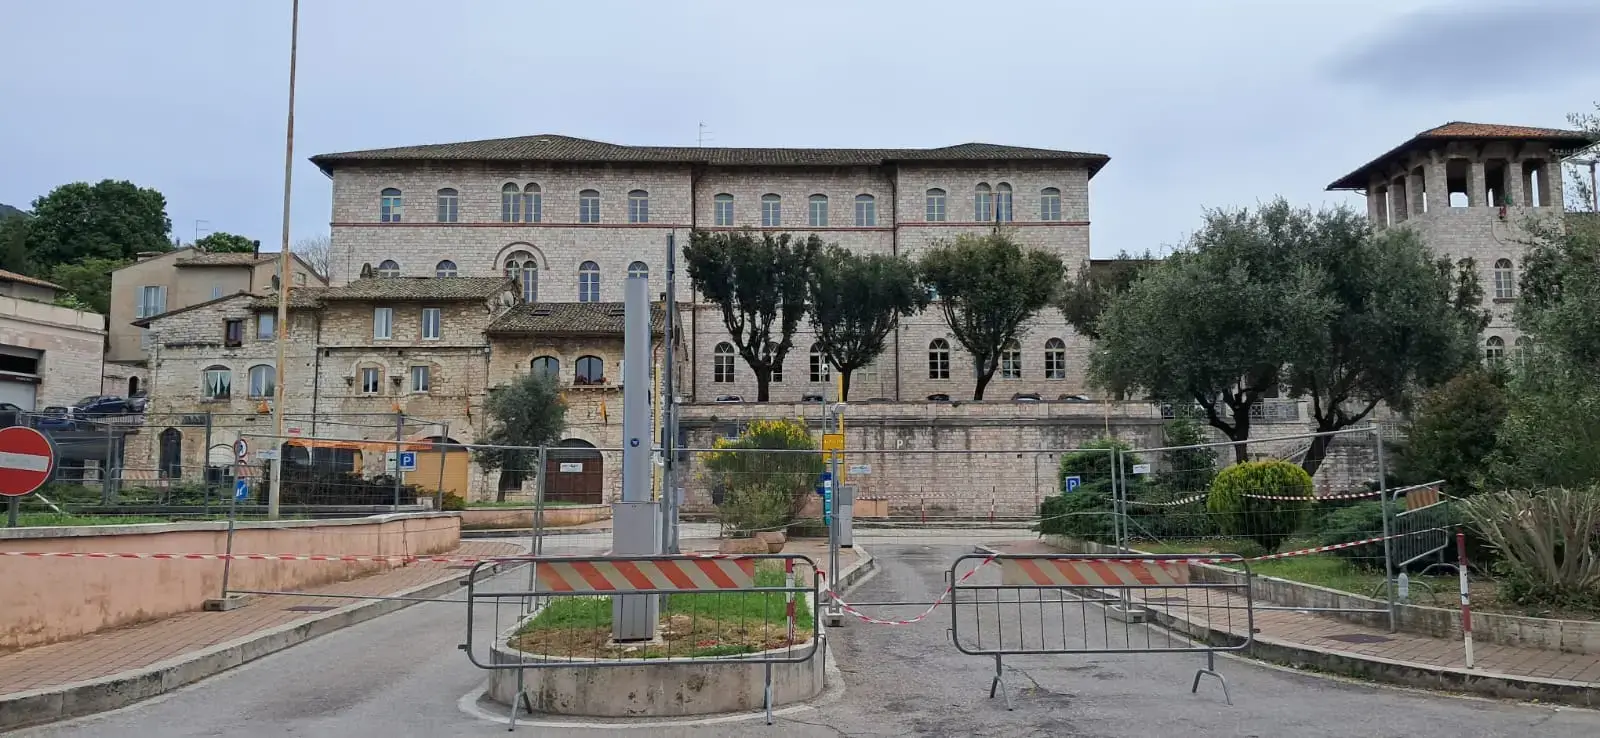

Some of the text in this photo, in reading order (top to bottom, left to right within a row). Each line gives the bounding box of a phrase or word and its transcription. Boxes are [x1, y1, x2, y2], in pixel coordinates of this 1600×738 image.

[897, 440, 904, 450] P
[403, 456, 411, 466] P
[1070, 480, 1077, 491] P
